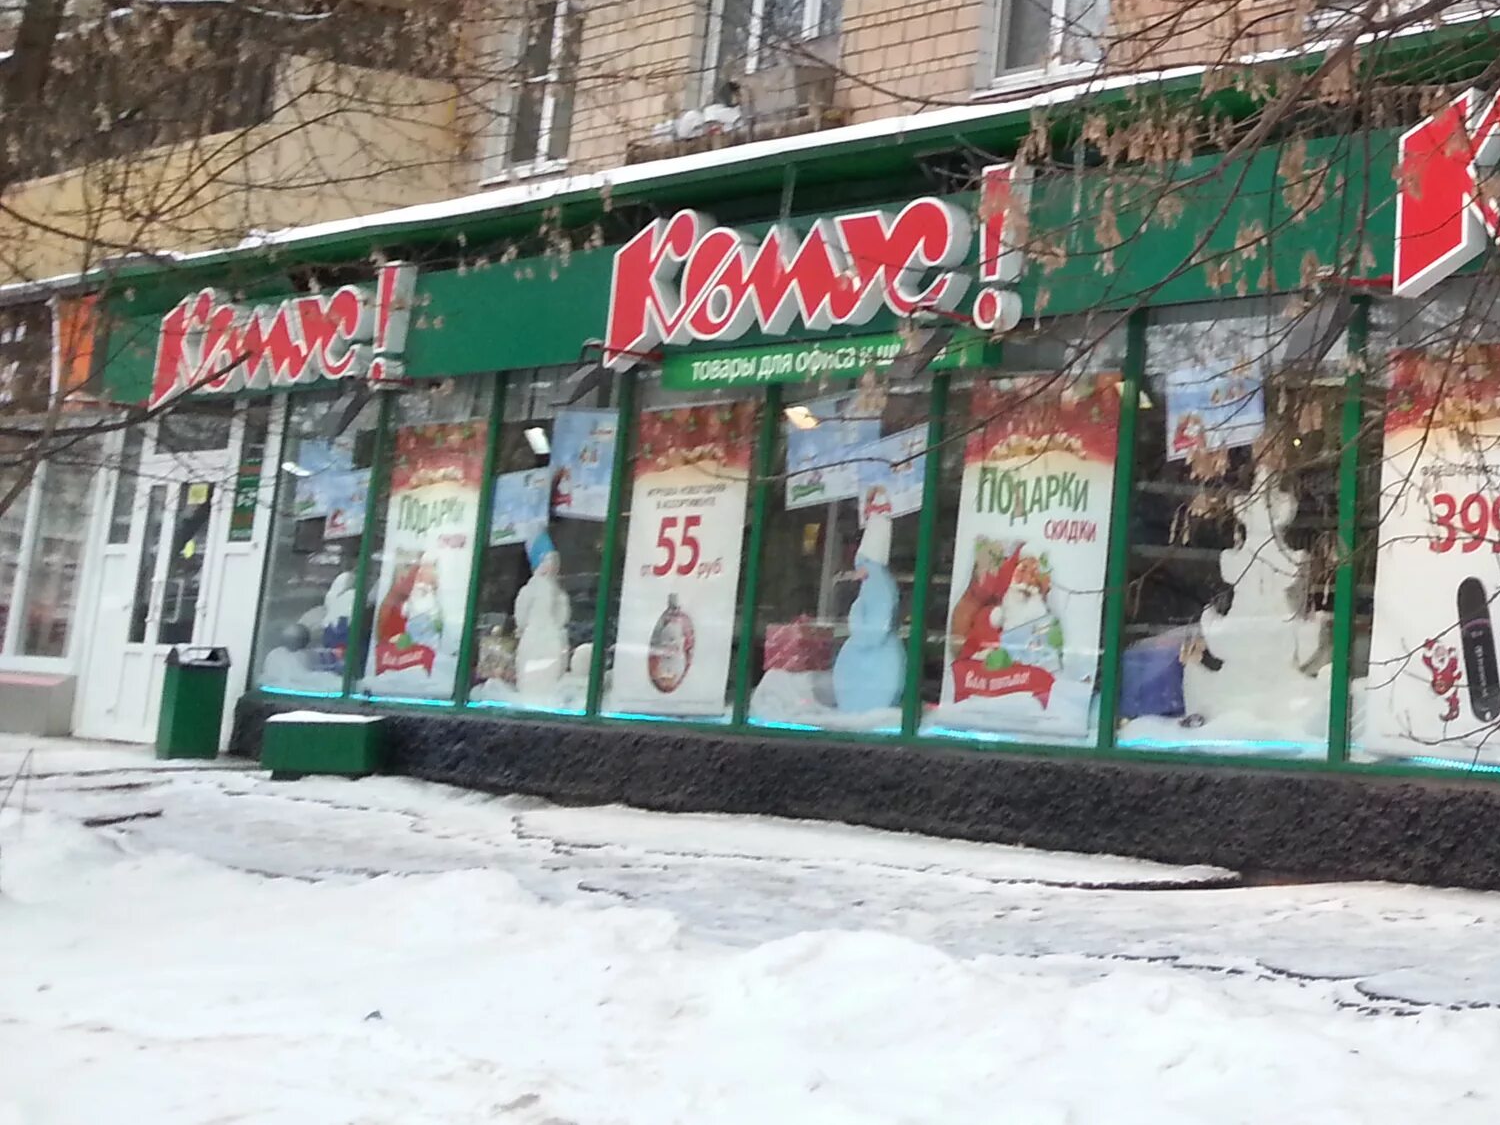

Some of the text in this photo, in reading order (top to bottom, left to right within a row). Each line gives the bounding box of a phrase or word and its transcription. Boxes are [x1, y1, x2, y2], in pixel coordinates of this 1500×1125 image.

[691, 356, 755, 383] товары
[757, 352, 793, 381] для
[795, 343, 856, 377] офиса
[653, 515, 702, 577] 55
